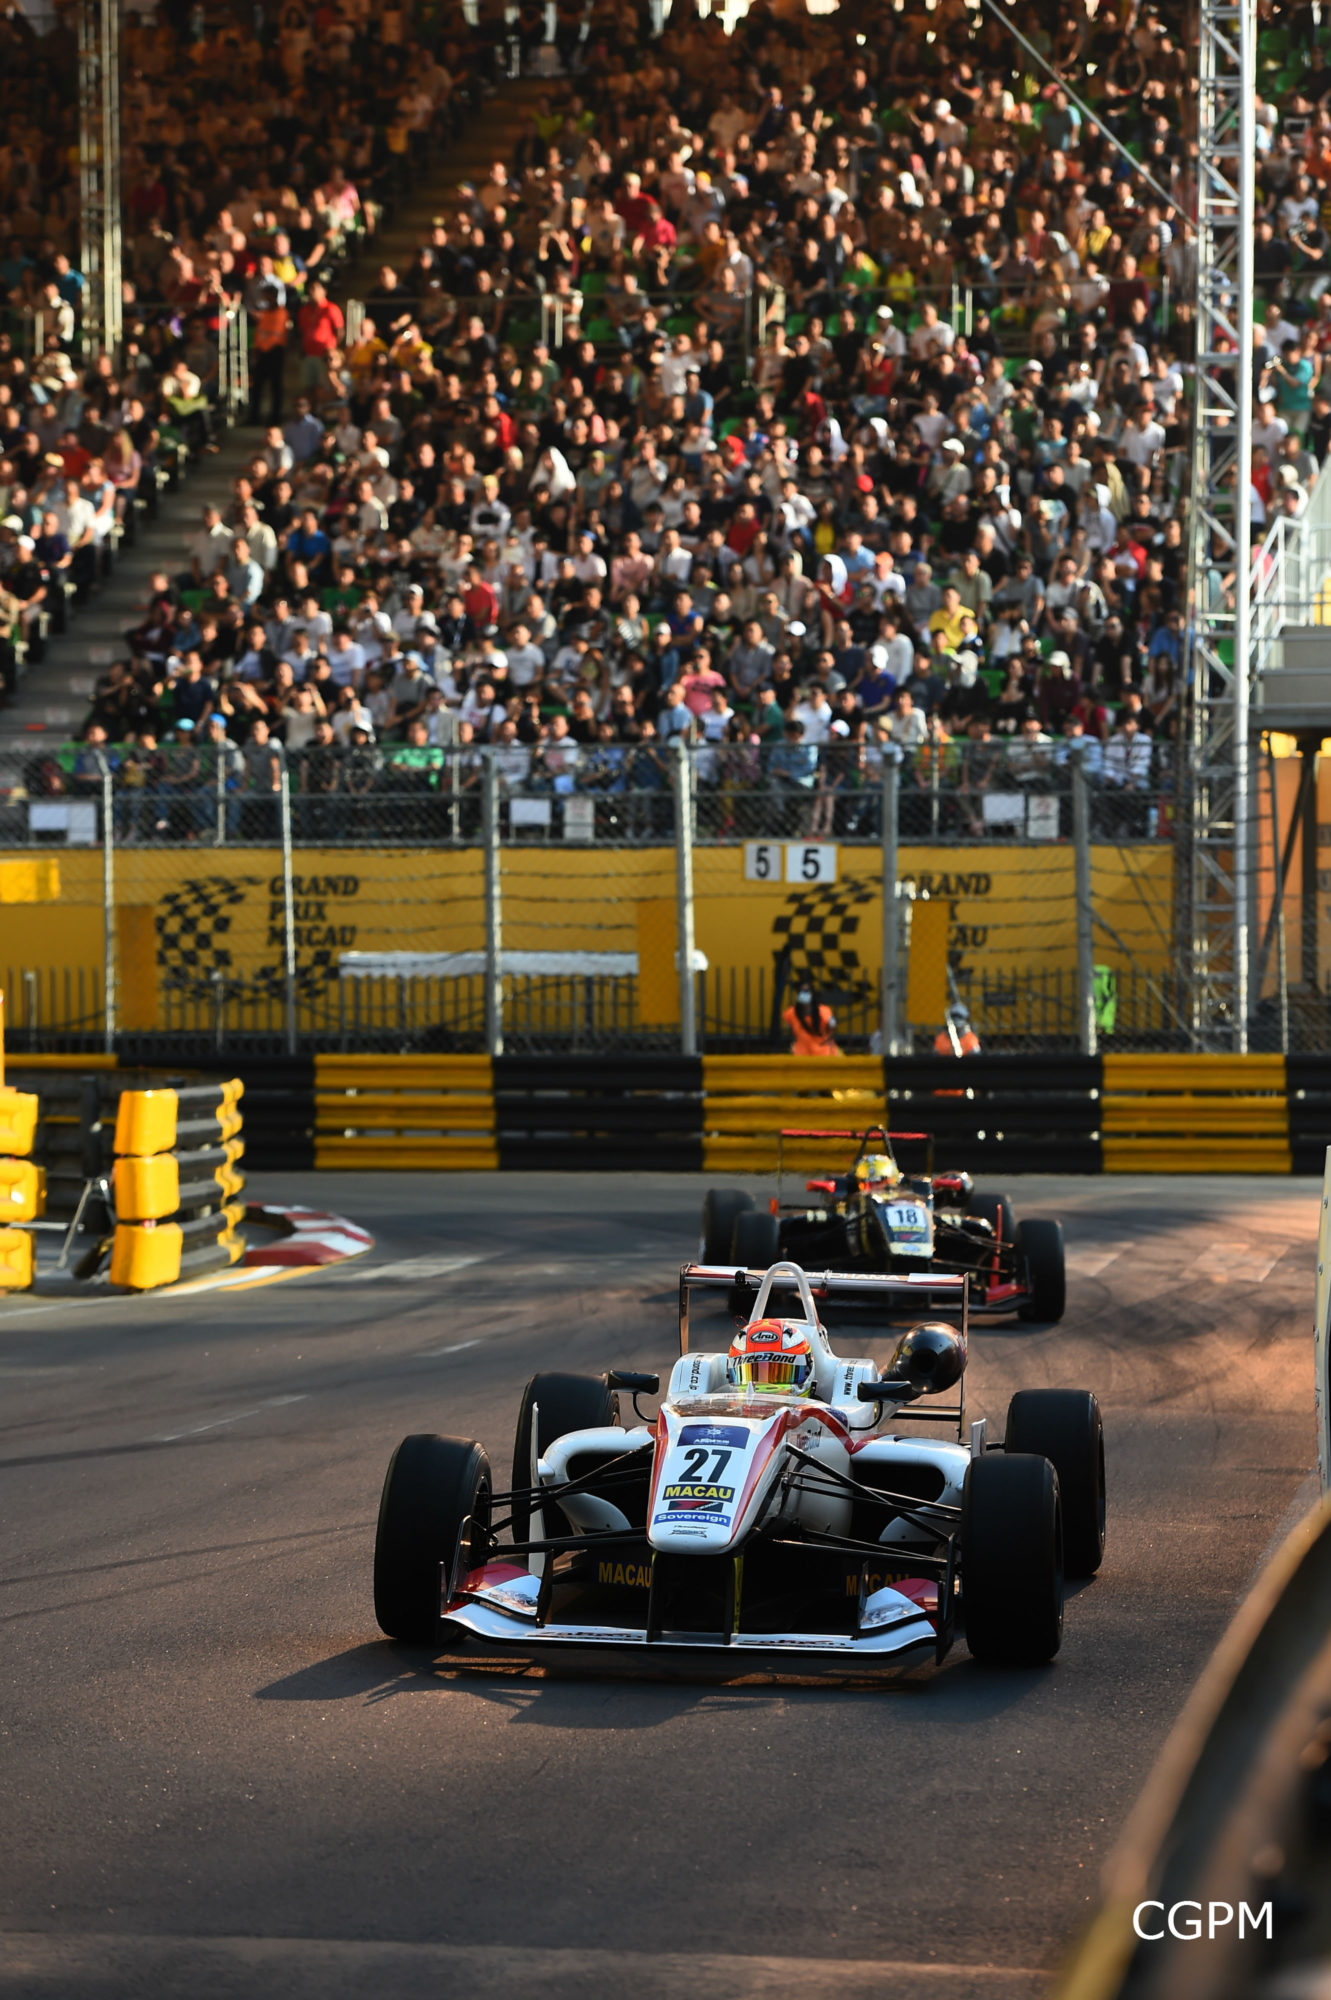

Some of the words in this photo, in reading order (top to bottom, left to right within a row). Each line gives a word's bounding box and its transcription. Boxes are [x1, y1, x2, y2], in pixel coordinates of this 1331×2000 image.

[756, 846, 770, 878] 5
[802, 849, 820, 879] 5
[269, 875, 359, 896] GRAND
[896, 1209, 918, 1224] 18
[755, 1331, 776, 1340] Arai
[733, 1352, 797, 1367] ThreeBond
[678, 1448, 732, 1483] 27
[665, 1486, 732, 1499] MACAU
[657, 1513, 727, 1523] Sovereign
[599, 1562, 652, 1588] MACAU
